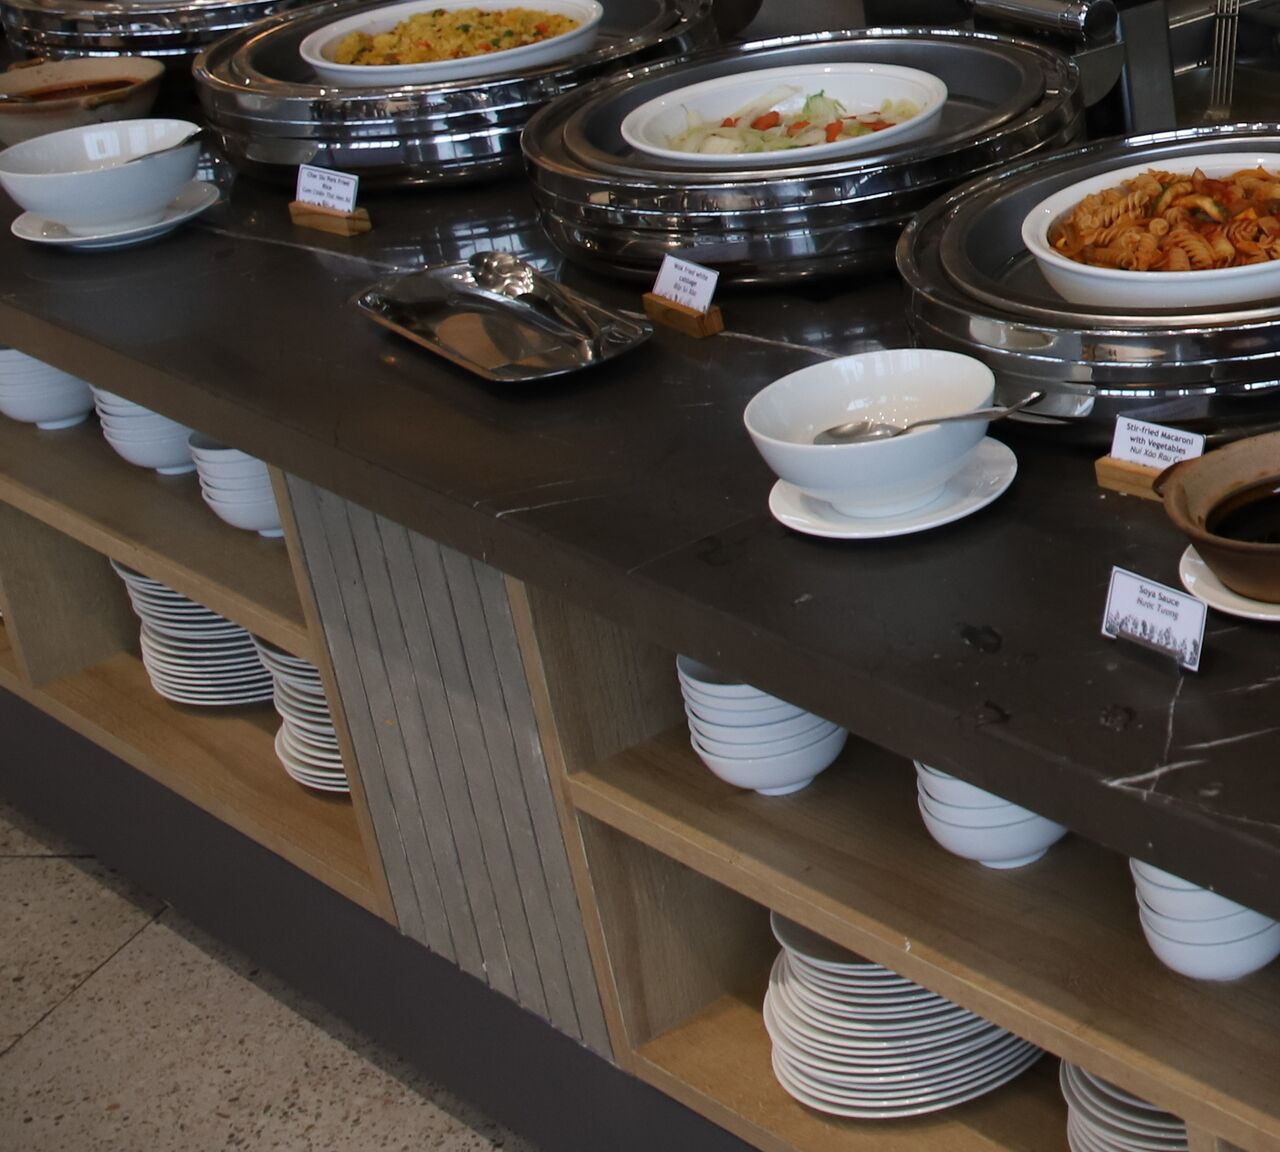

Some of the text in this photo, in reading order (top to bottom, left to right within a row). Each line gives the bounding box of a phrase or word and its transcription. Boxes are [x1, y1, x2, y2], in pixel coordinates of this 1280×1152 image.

[1126, 422, 1194, 445] Stir-fried Macaroni
[1130, 436, 1186, 455] with Vegetables
[1139, 584, 1180, 607] Soya Sauce
